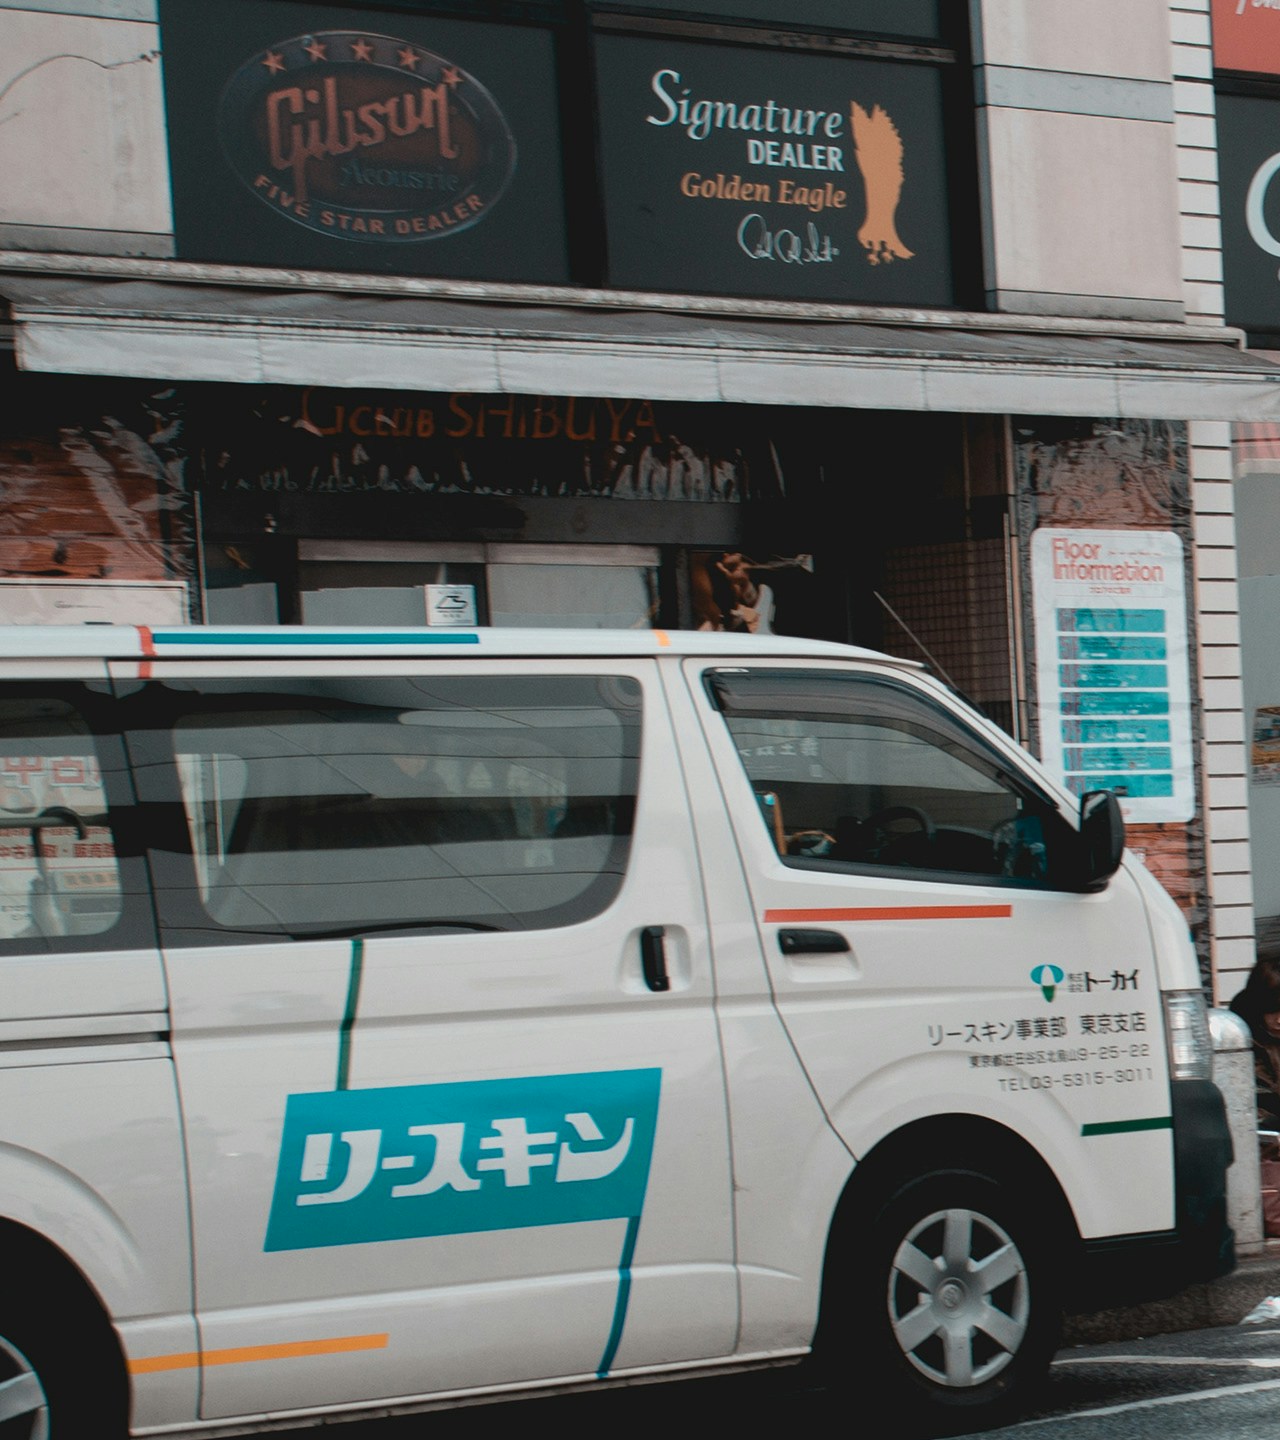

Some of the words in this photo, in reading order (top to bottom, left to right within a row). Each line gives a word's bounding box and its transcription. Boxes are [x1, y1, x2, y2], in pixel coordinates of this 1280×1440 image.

[647, 68, 846, 142] Signature
[265, 77, 459, 205] Gibson
[746, 139, 845, 173] DEALER
[253, 173, 311, 220] FIVE
[320, 210, 386, 235] STAR
[394, 193, 486, 236] DEALER
[680, 172, 771, 204] Golden
[777, 179, 847, 213] Eagle
[446, 392, 661, 443] SHIBUYA
[1052, 537, 1102, 559] Floor
[1053, 560, 1165, 582] Information
[1084, 969, 1139, 992] トーカイ
[927, 1017, 1067, 1047] リースキン事業部
[1081, 1011, 1147, 1035] 東京支店
[295, 1111, 635, 1207] リースキン
